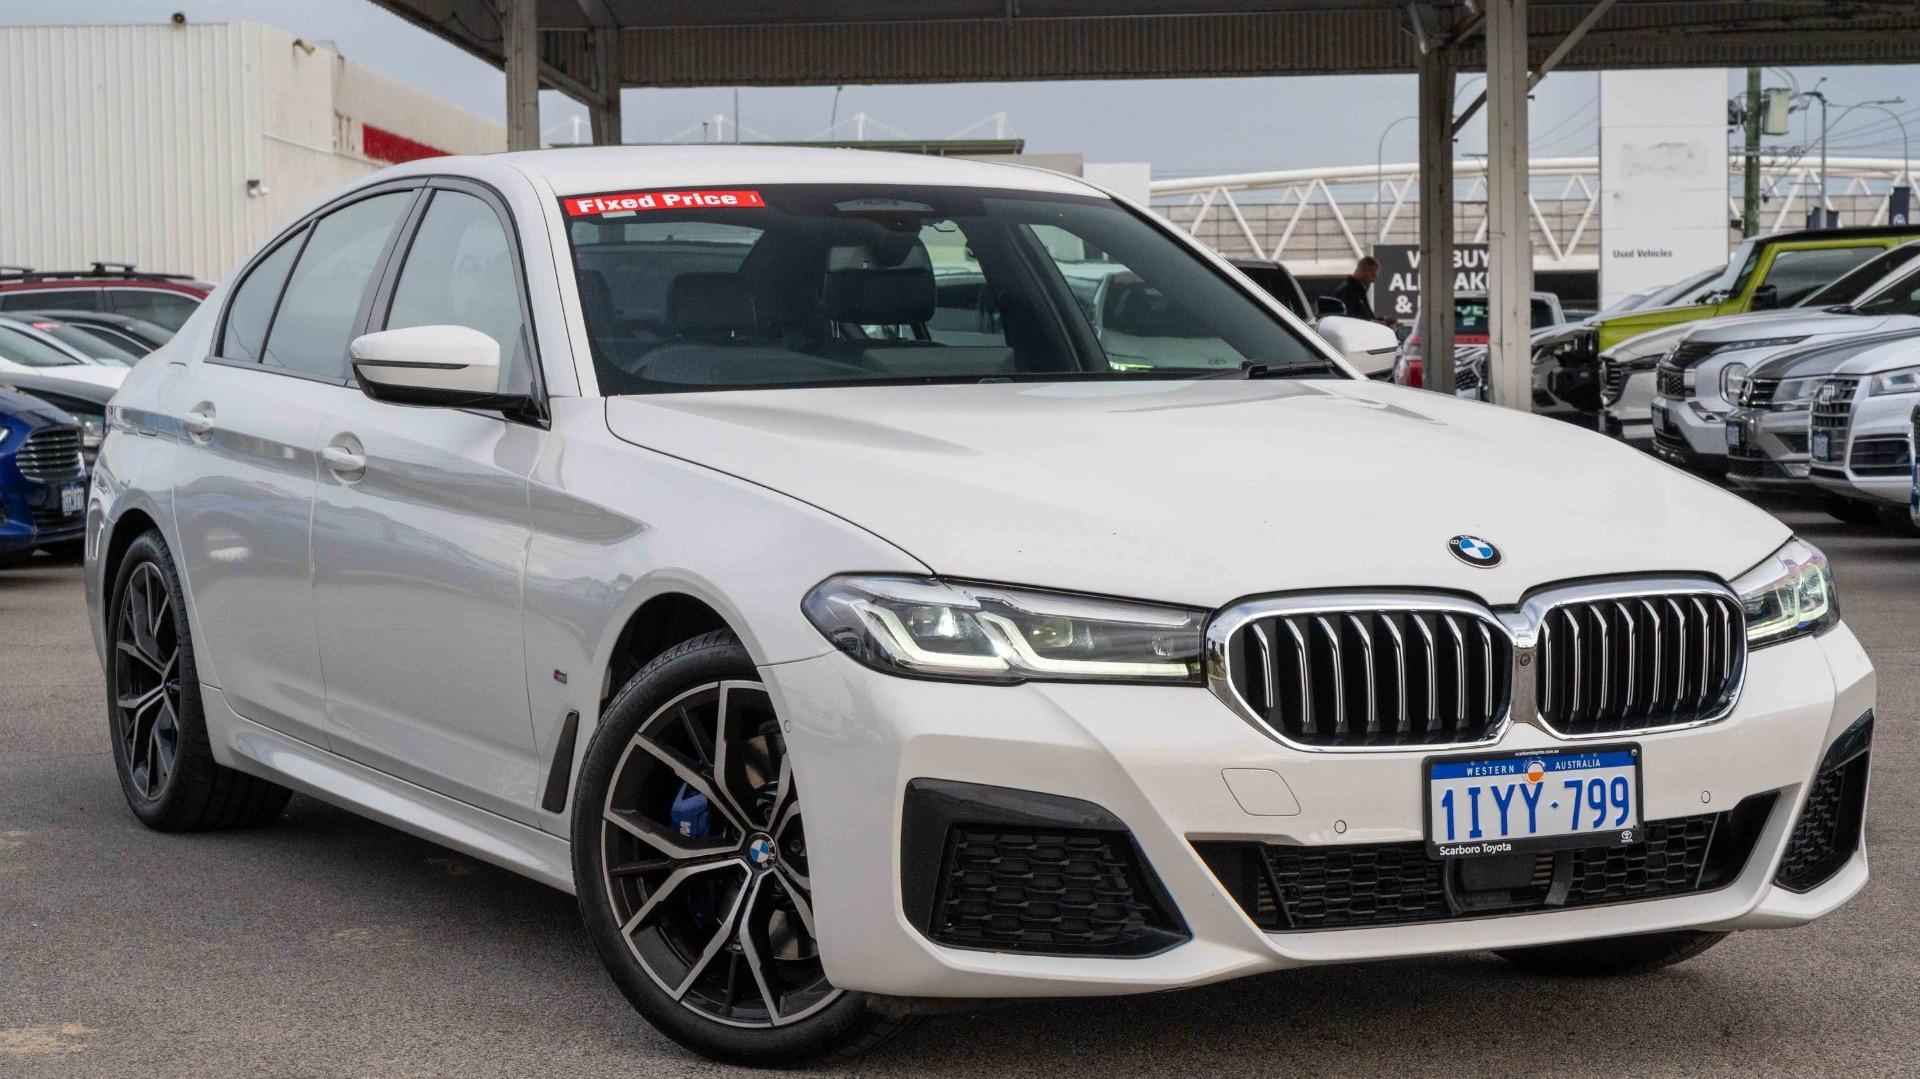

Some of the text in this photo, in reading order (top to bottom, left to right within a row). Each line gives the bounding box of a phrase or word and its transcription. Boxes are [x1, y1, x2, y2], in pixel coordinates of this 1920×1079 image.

[576, 194, 656, 213] Fixed
[662, 191, 738, 207] Price
[1612, 248, 1673, 259] Used Vehicles
[1388, 272, 1421, 291] AL
[1394, 294, 1413, 314] &
[1466, 758, 1601, 776] WESTERN AUSTRALIA
[1439, 842, 1512, 856] Scarboro Toyota
